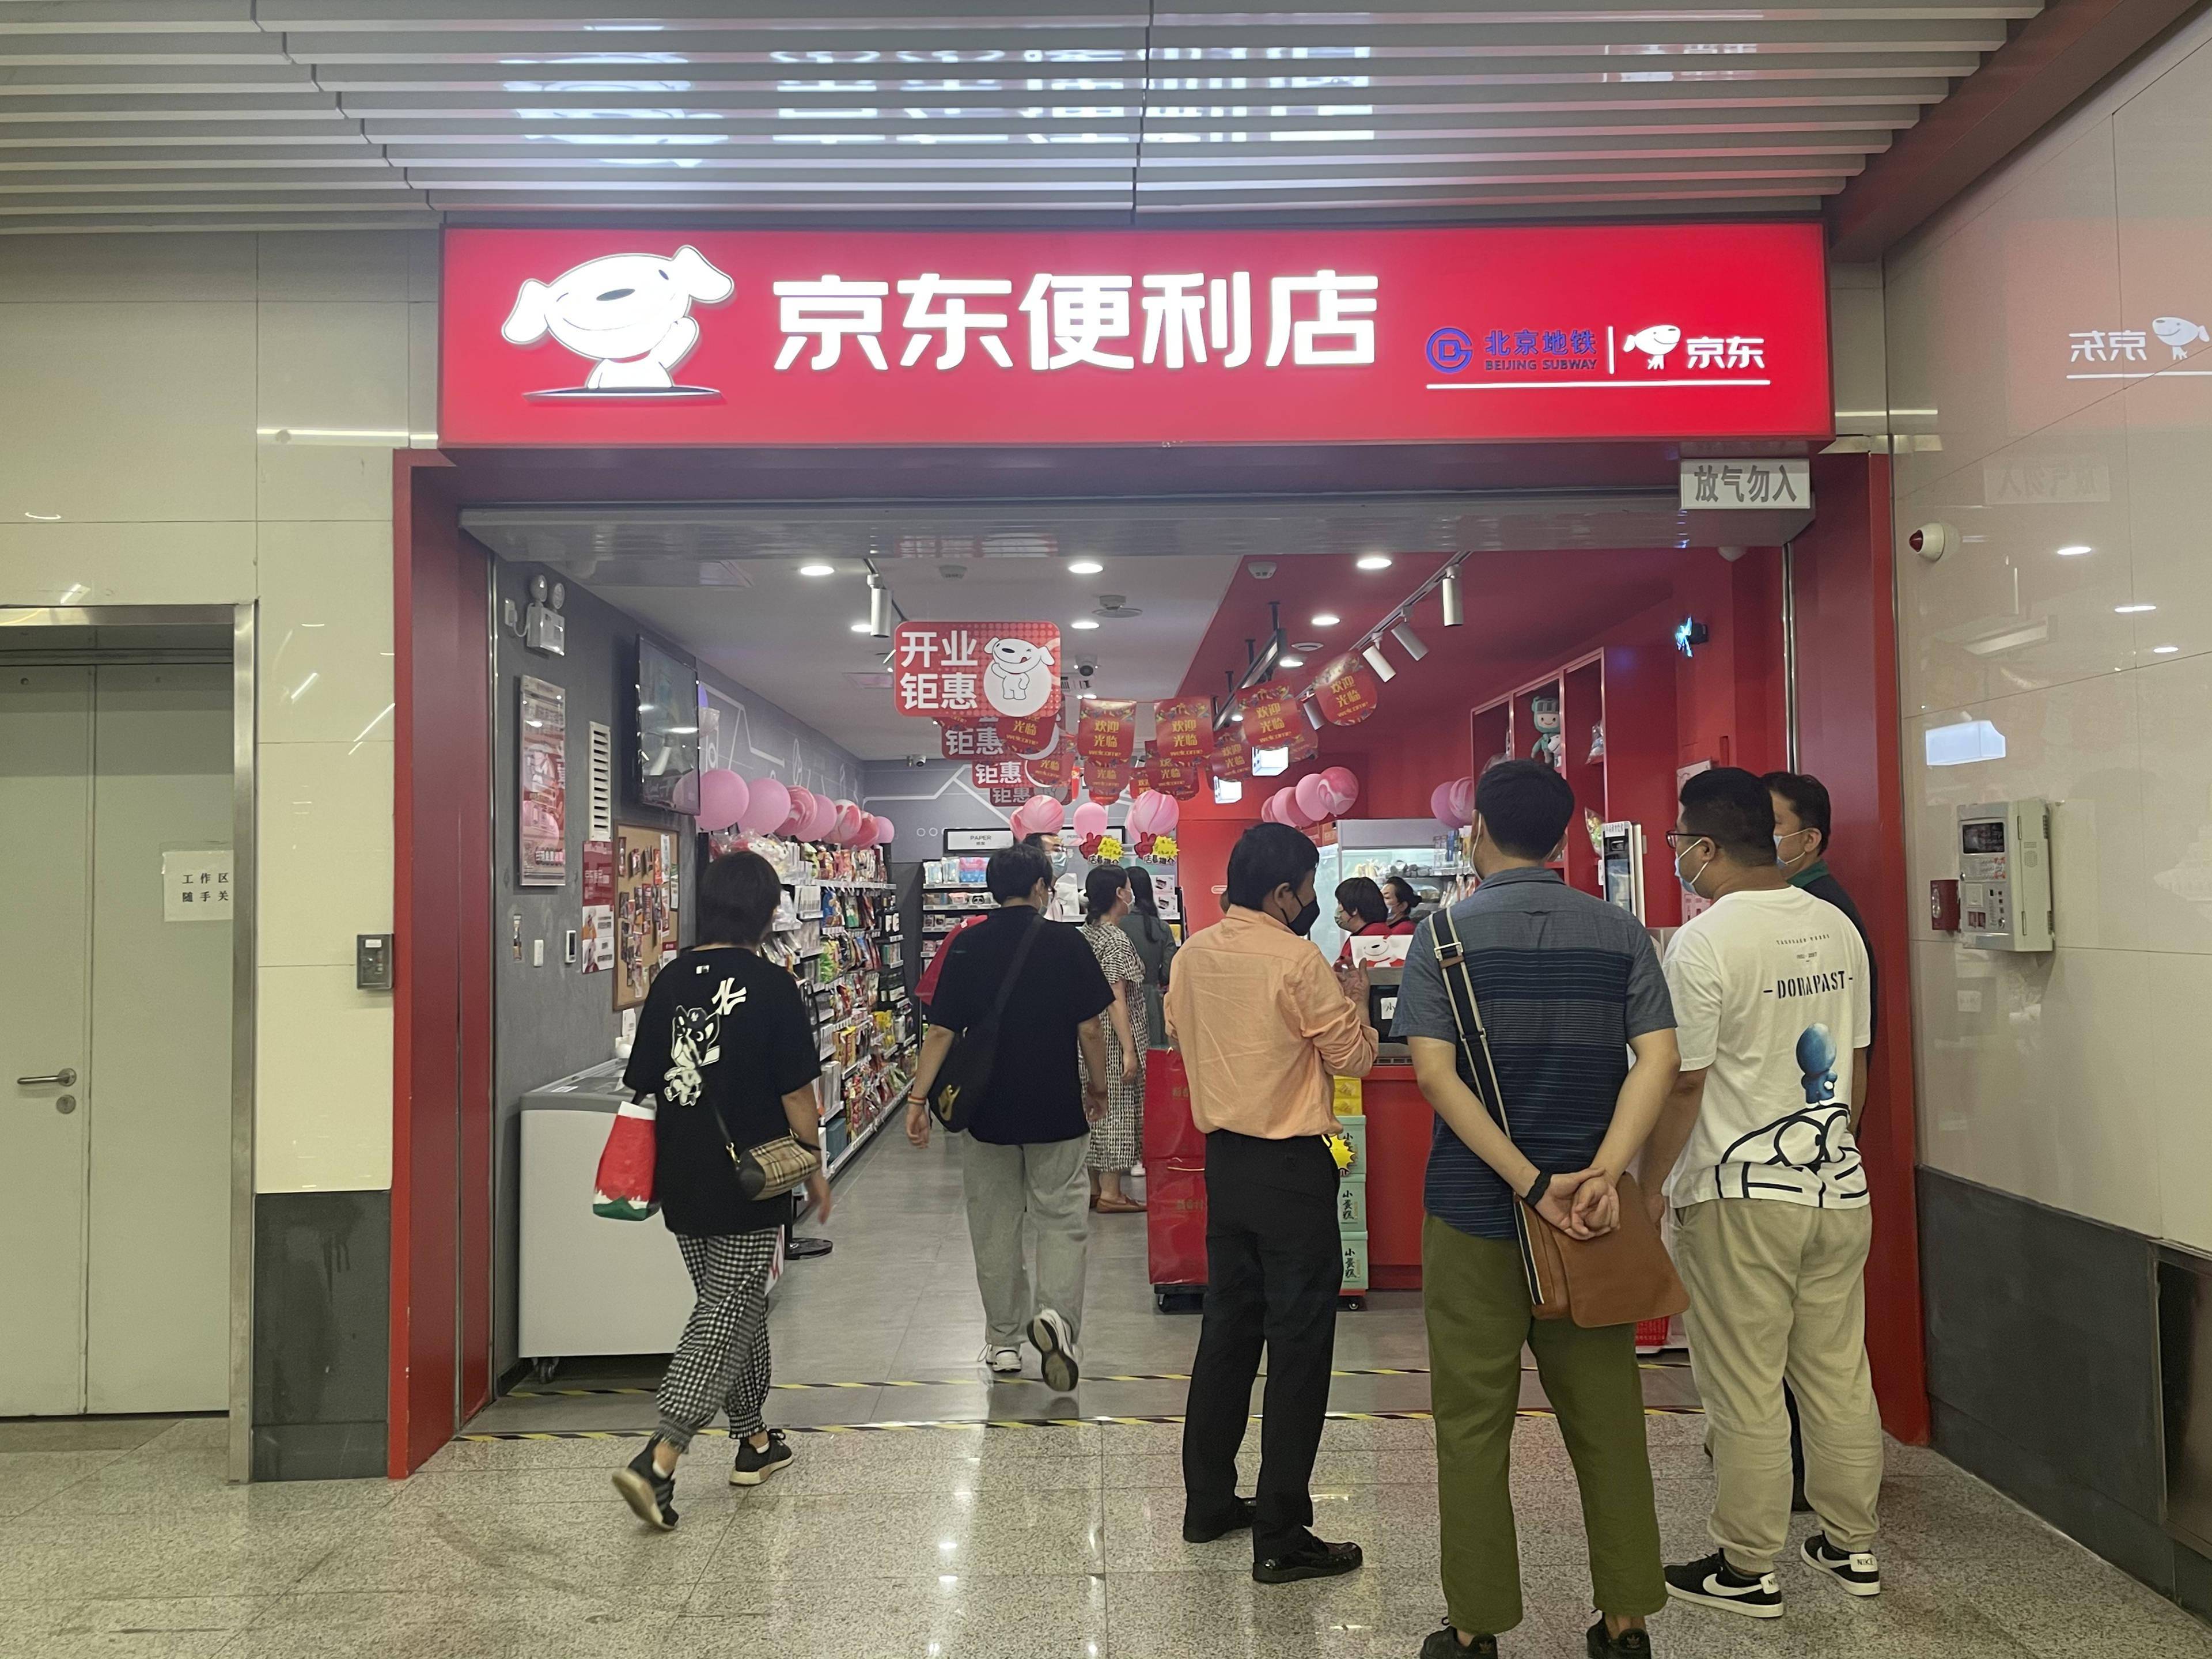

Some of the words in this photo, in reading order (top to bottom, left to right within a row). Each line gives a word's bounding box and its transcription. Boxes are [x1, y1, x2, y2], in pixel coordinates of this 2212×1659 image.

[772, 270, 1379, 372] 京东便利店
[1486, 329, 1597, 355] 北京地铁
[1687, 336, 1765, 369] 京东
[1485, 359, 1537, 370] BEIJING
[1542, 358, 1597, 370] SUBWAY
[1694, 464, 1797, 502] 放气勿入
[900, 630, 978, 668] 开业
[900, 672, 978, 710] 钜惠
[1094, 720, 1119, 733] 欢迎
[1172, 719, 1197, 733] 欢迎
[945, 726, 1004, 756] 钜惠
[1093, 735, 1118, 748] 光临
[1173, 734, 1198, 747] 光临
[975, 761, 1022, 784] 钜惠
[182, 872, 229, 884] 工作区
[182, 890, 229, 903] 随手关
